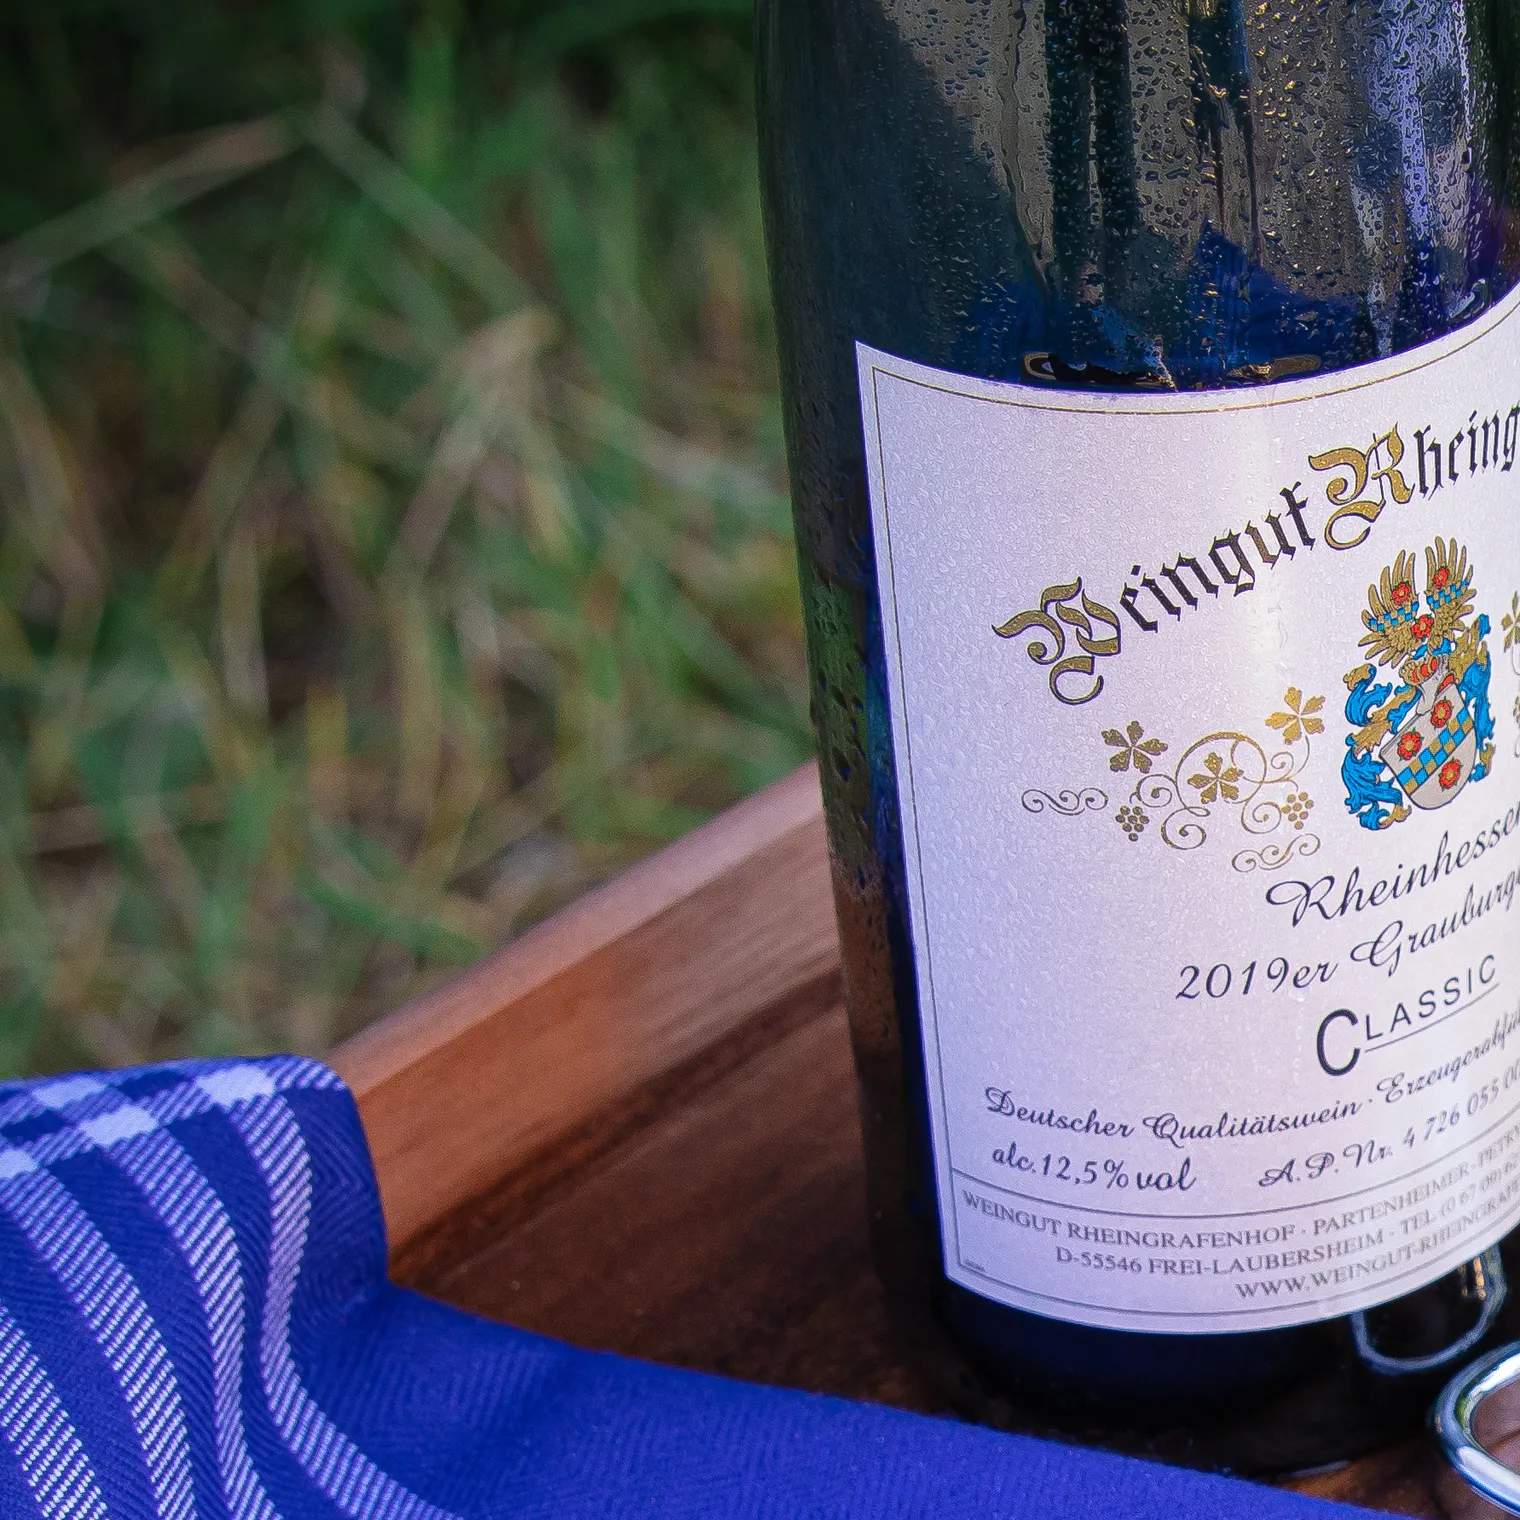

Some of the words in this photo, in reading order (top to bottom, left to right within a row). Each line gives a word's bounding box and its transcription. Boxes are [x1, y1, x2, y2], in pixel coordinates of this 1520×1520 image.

[991, 479, 1316, 705] Weingut
[1175, 955, 1339, 1000] 2019er
[1316, 954, 1496, 1077] CLASSIC
[984, 1085, 1135, 1138] Deutscher
[1142, 1099, 1362, 1149] Qualitätswein
[1423, 1103, 1461, 1142] 726
[962, 1188, 1062, 1236] WEINGUT
[1067, 1221, 1297, 1250] RHEINGRAFENHOF
[1055, 1246, 1143, 1274] D-55546
[1149, 1229, 1385, 1276] FREI-LAUBERSHEIM
